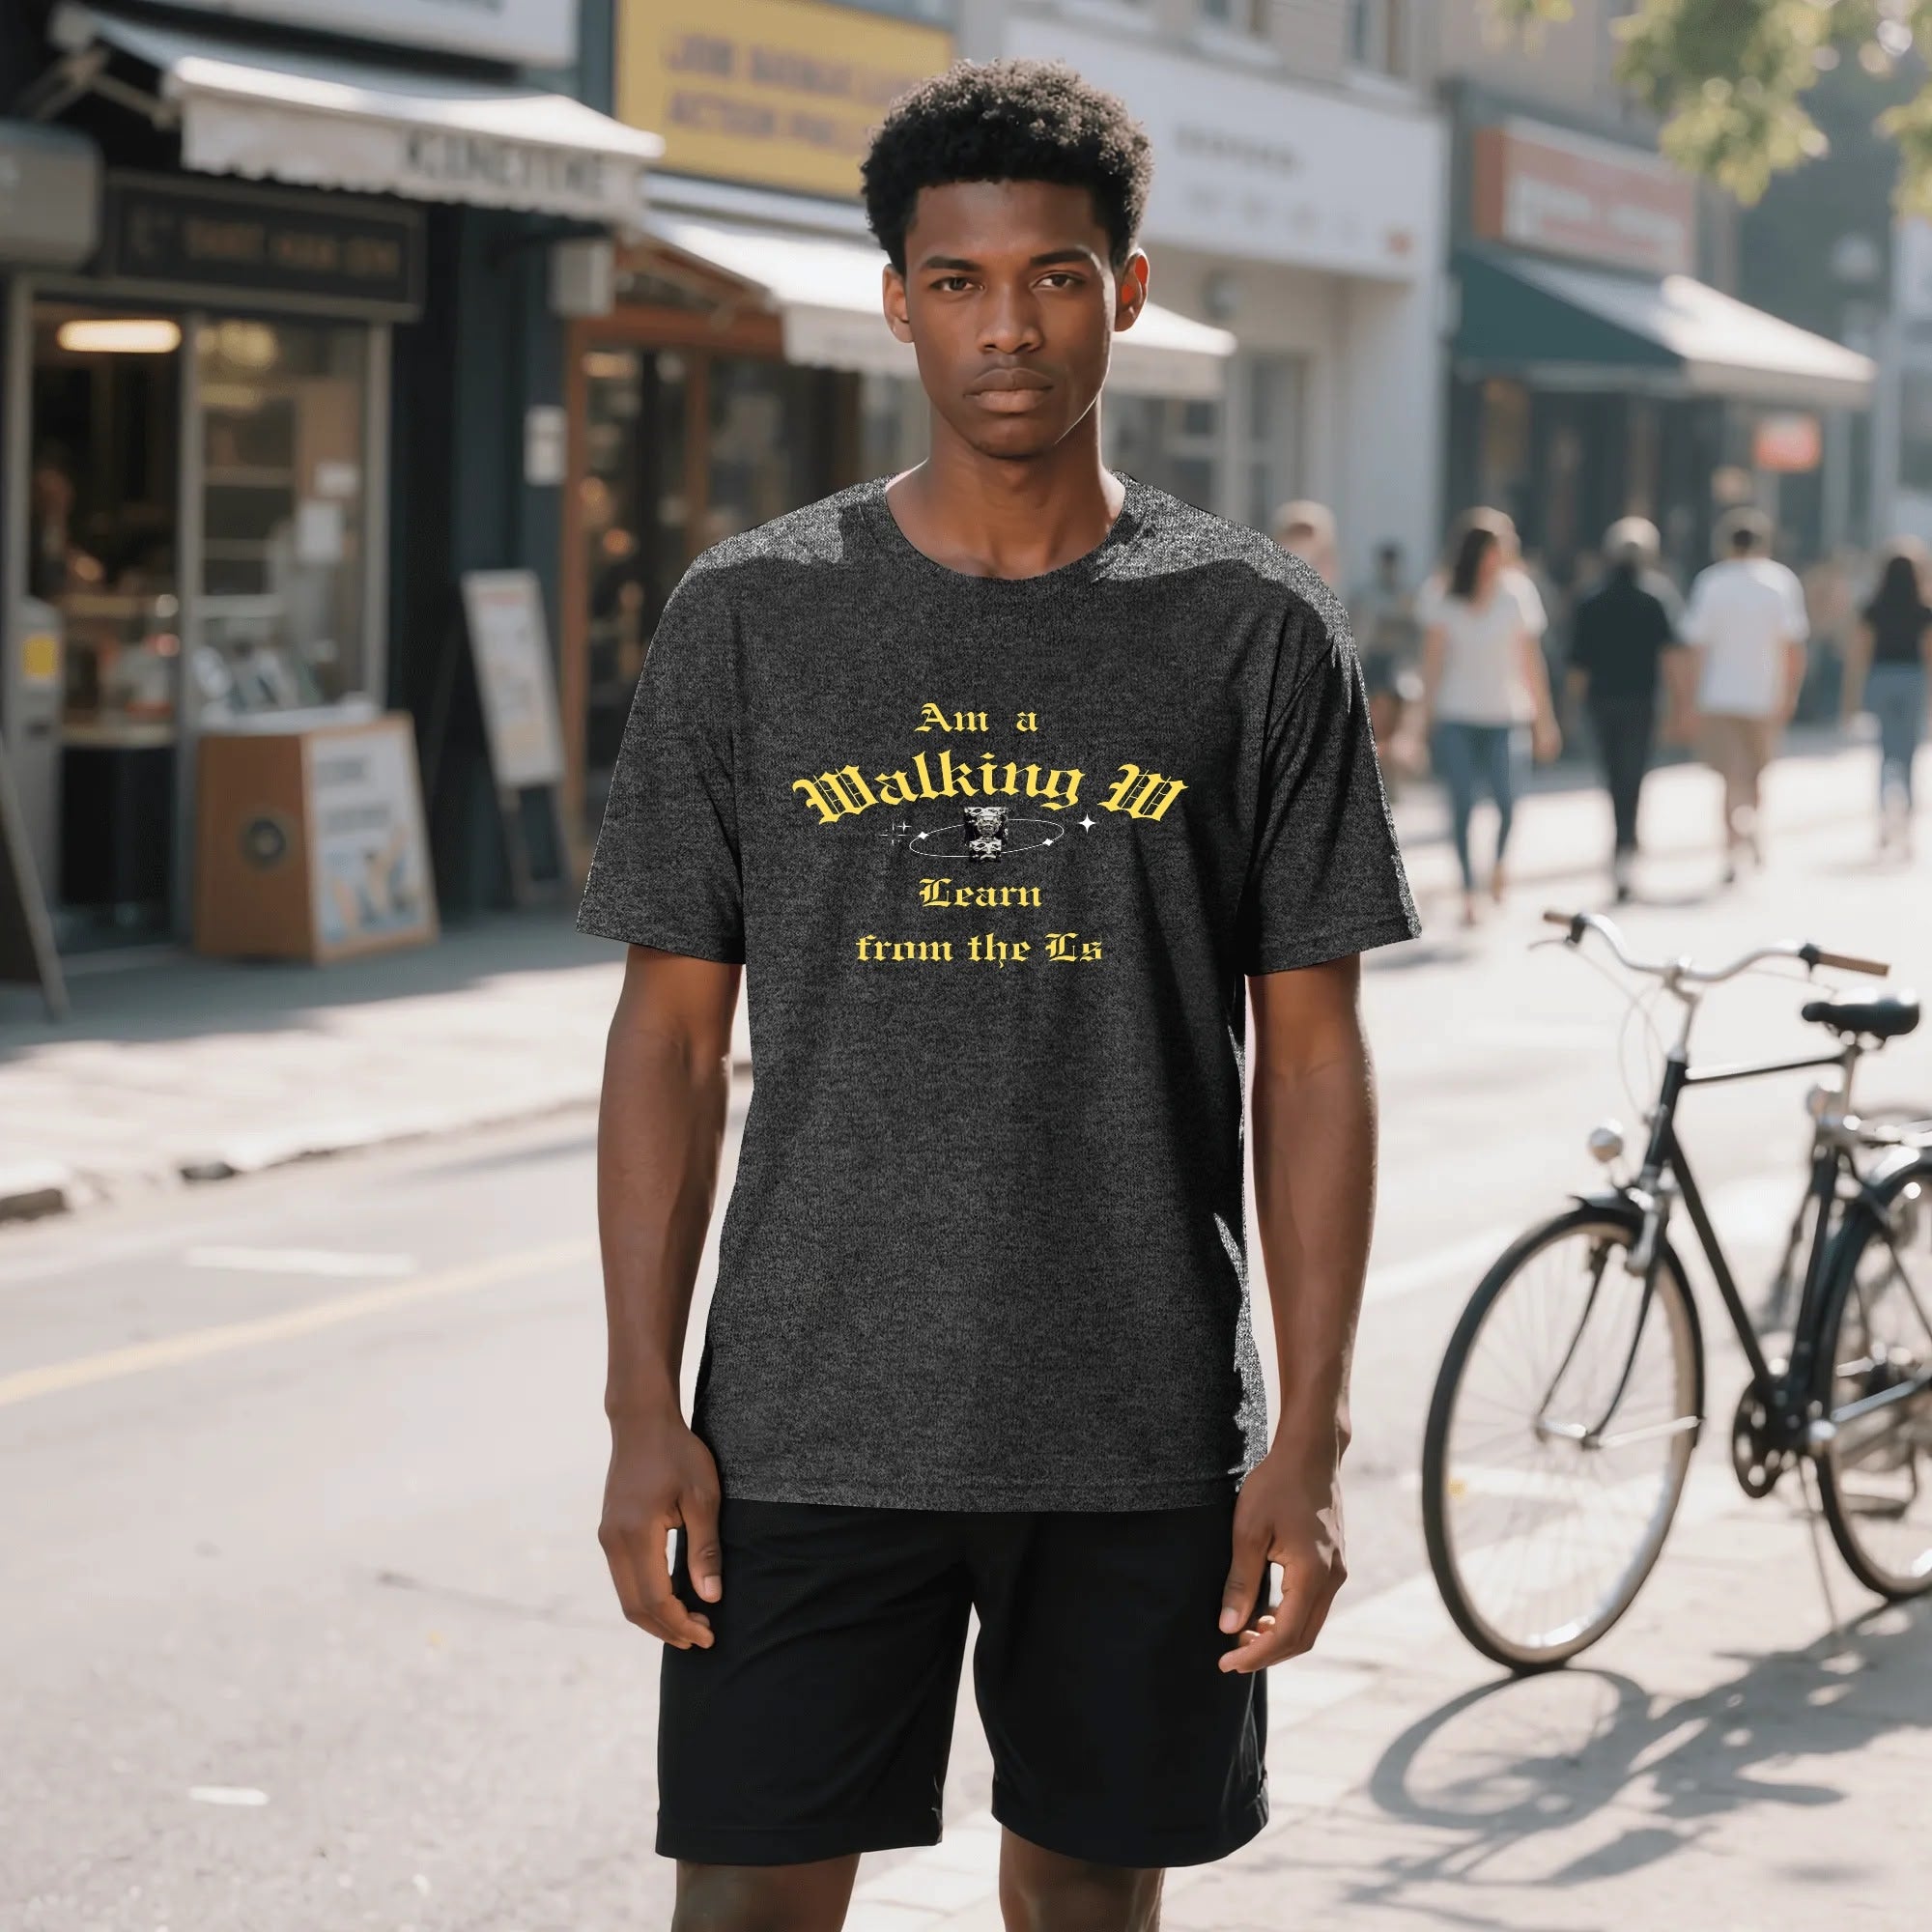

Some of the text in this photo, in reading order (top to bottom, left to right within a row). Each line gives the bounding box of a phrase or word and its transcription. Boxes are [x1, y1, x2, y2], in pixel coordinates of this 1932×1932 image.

[915, 702, 1038, 733] Am a
[792, 750, 1188, 825] Walking W
[919, 878, 1042, 907] Learn
[856, 932, 1103, 968] from the Ls
